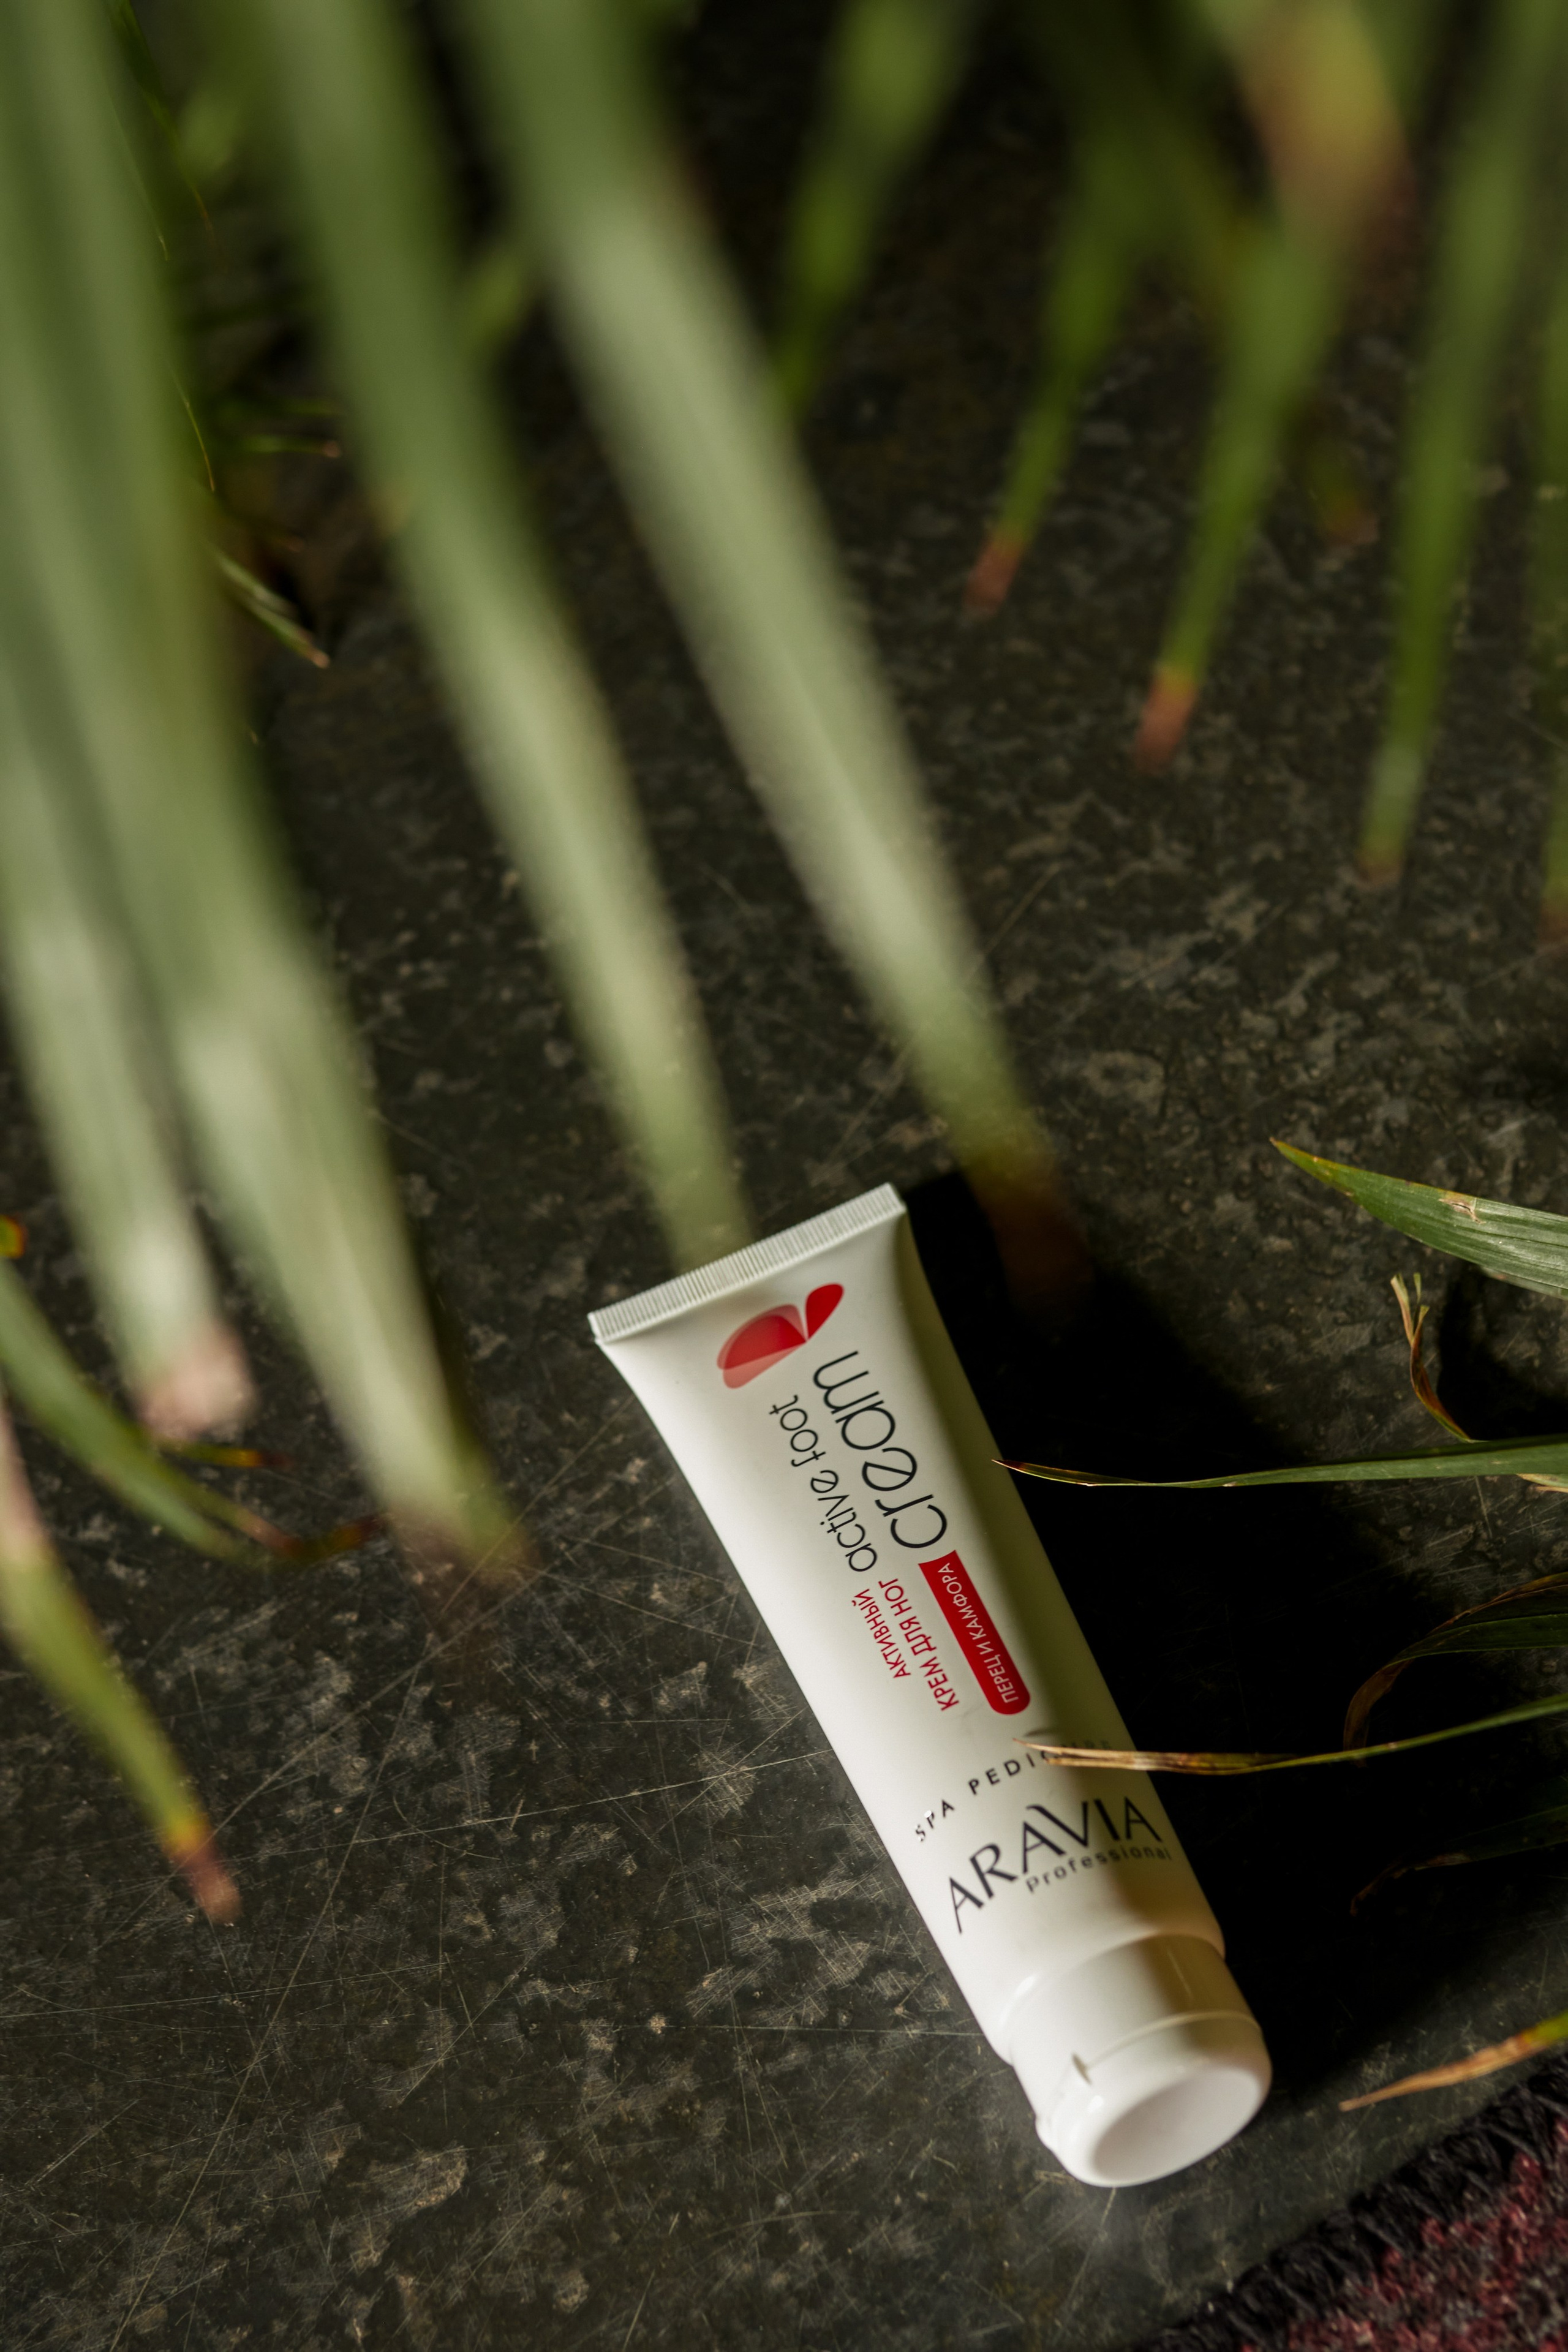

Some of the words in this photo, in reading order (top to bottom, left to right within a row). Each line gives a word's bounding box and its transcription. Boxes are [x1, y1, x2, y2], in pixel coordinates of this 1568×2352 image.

[769, 1395, 826, 1467] foot
[813, 1351, 947, 1548] cream
[810, 1470, 877, 1572] active
[878, 1578, 912, 1616] НОГ
[938, 1562, 987, 1640] КАМФОРА
[851, 1589, 911, 1678] АКТИВНЫЙ
[899, 1616, 937, 1656] ДЛЯ
[976, 1641, 993, 1654] И
[919, 1656, 959, 1711] КРЕМ
[984, 1654, 1019, 1703] ПЕРЕЦ
[915, 1800, 954, 1841] SPA
[949, 1796, 1163, 1934] ARAVIA
